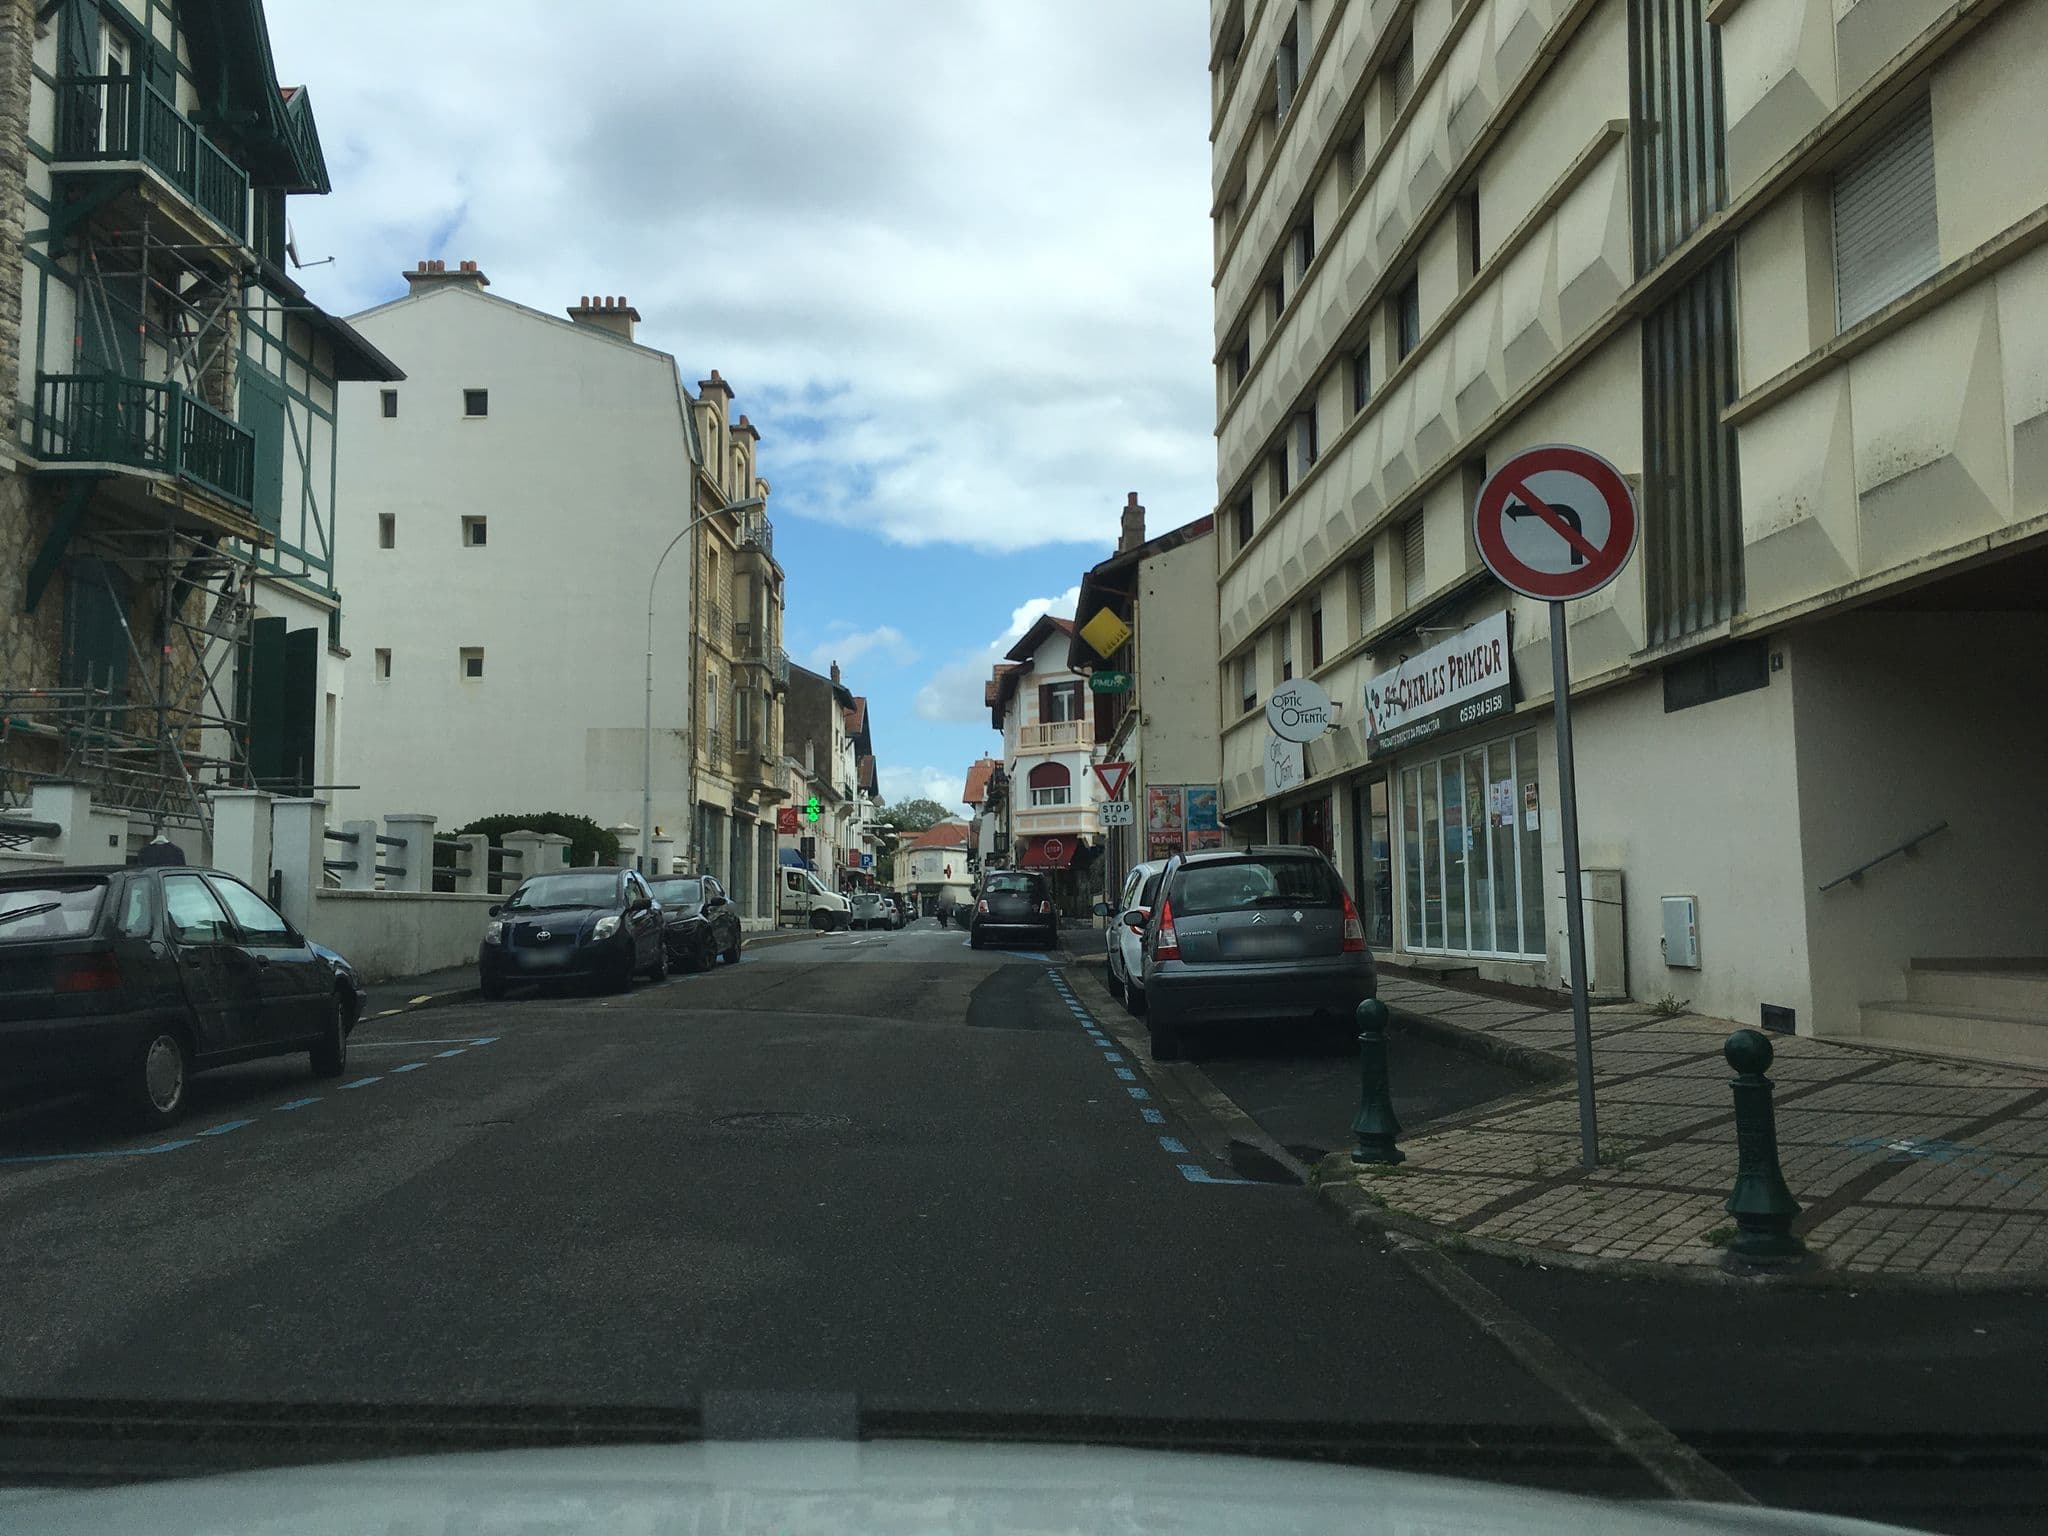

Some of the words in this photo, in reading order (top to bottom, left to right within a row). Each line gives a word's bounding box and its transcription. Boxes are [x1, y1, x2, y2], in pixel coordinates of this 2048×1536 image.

[1399, 665, 1445, 711] CHARLES
[1448, 639, 1502, 692] PRIMEUR
[1092, 678, 1114, 688] PMU
[1272, 696, 1302, 707] OPTIC
[1282, 708, 1327, 726] OTENTIC
[1102, 804, 1129, 813] STOP
[1104, 815, 1117, 823] 50
[864, 856, 870, 864] P
